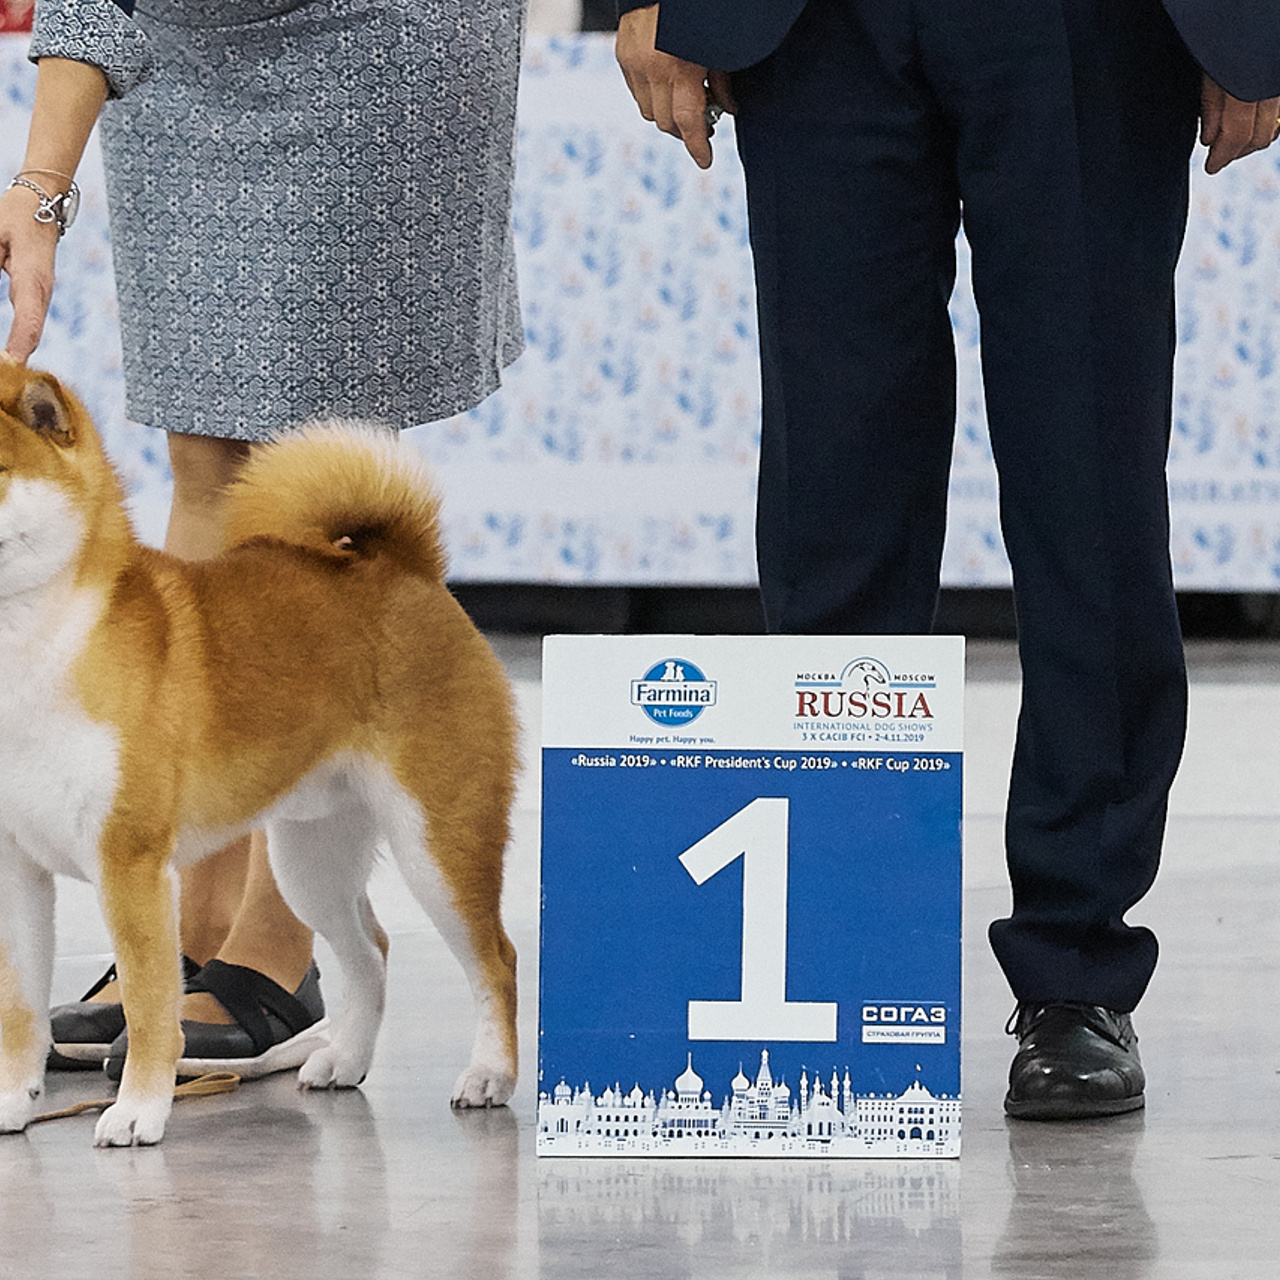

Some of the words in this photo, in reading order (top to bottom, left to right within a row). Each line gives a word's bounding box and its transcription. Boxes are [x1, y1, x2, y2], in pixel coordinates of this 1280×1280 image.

[637, 683, 710, 702] Farmina
[795, 691, 934, 718] RUSSIA
[793, 722, 871, 731] INTERNATIONAL
[875, 723, 896, 731] DOG
[898, 723, 934, 732] SHOWS
[802, 733, 808, 741] 3
[819, 733, 848, 741] CACIB
[850, 733, 866, 741] FCI
[704, 755, 771, 769] President's
[773, 756, 797, 771] Cup
[885, 758, 910, 773] Cup
[678, 797, 838, 1042] 1
[862, 1006, 946, 1023] СОГАЗ
